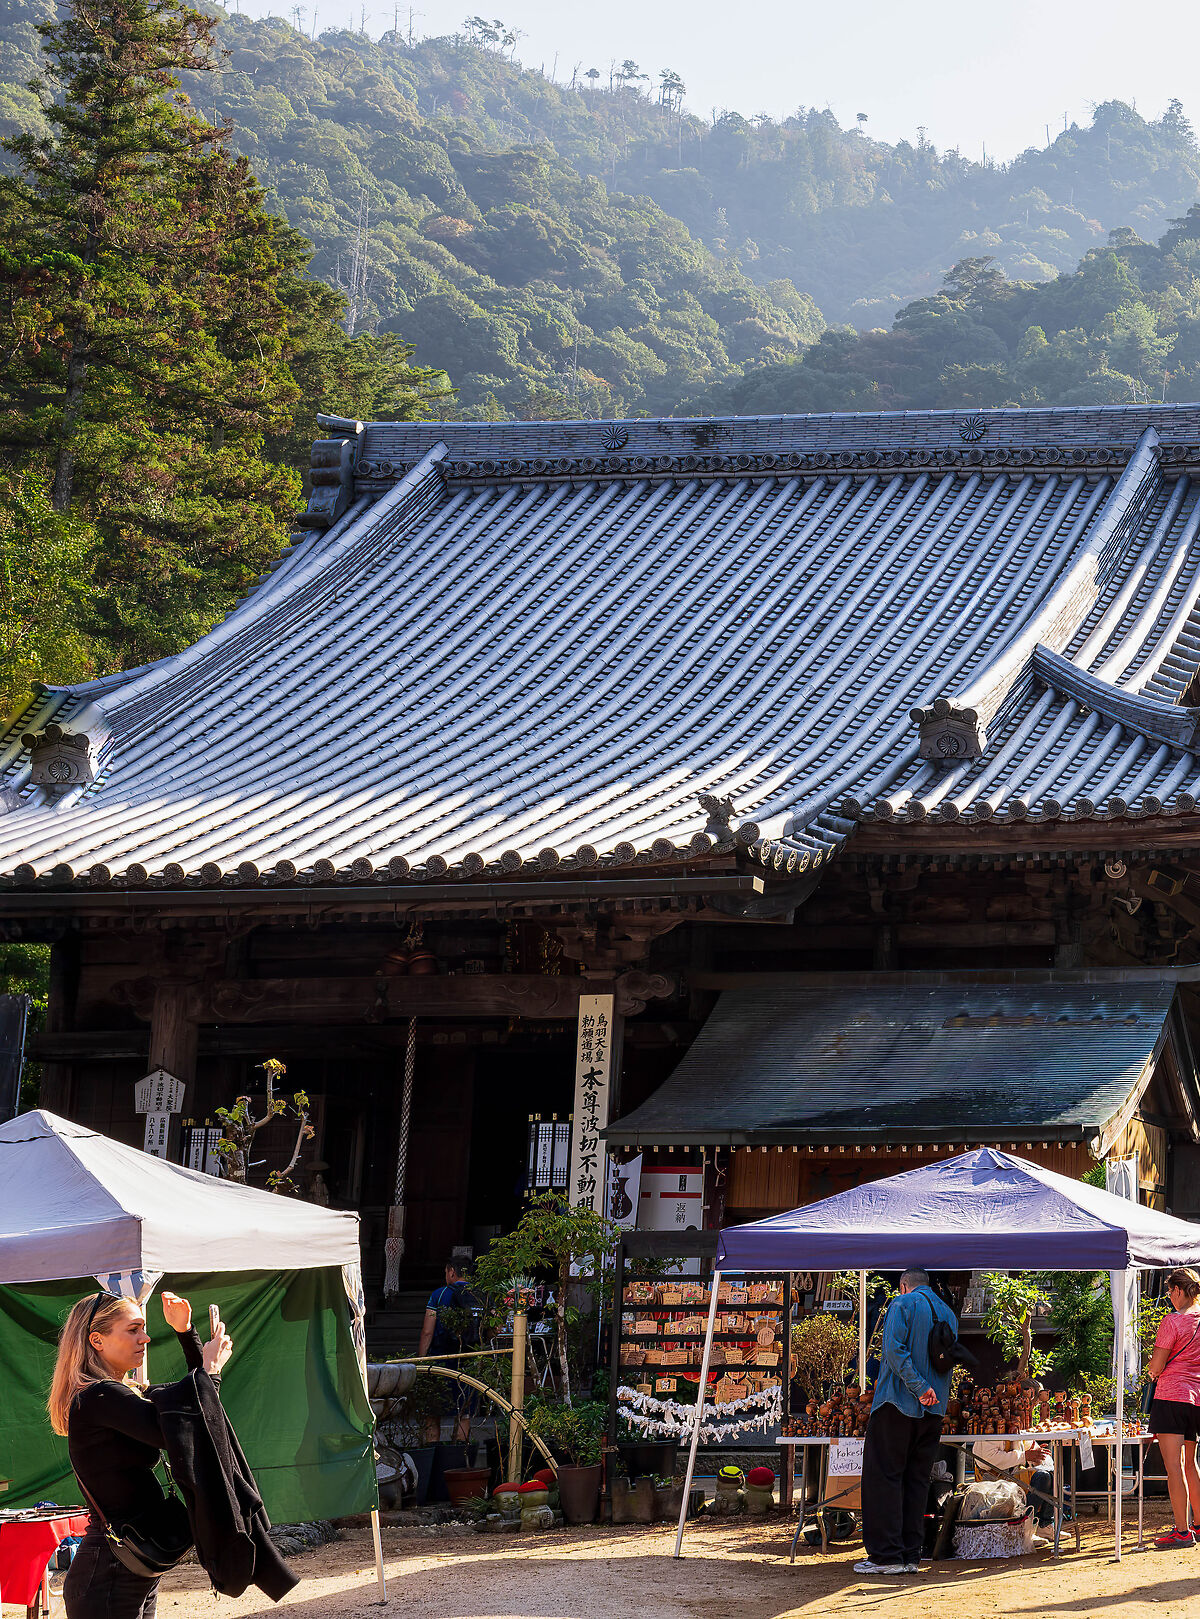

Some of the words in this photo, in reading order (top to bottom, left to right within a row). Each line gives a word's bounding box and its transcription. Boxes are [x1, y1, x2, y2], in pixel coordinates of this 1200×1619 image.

[594, 1013, 608, 1063] 鳥羽天皇
[675, 1202, 687, 1224] 返納
